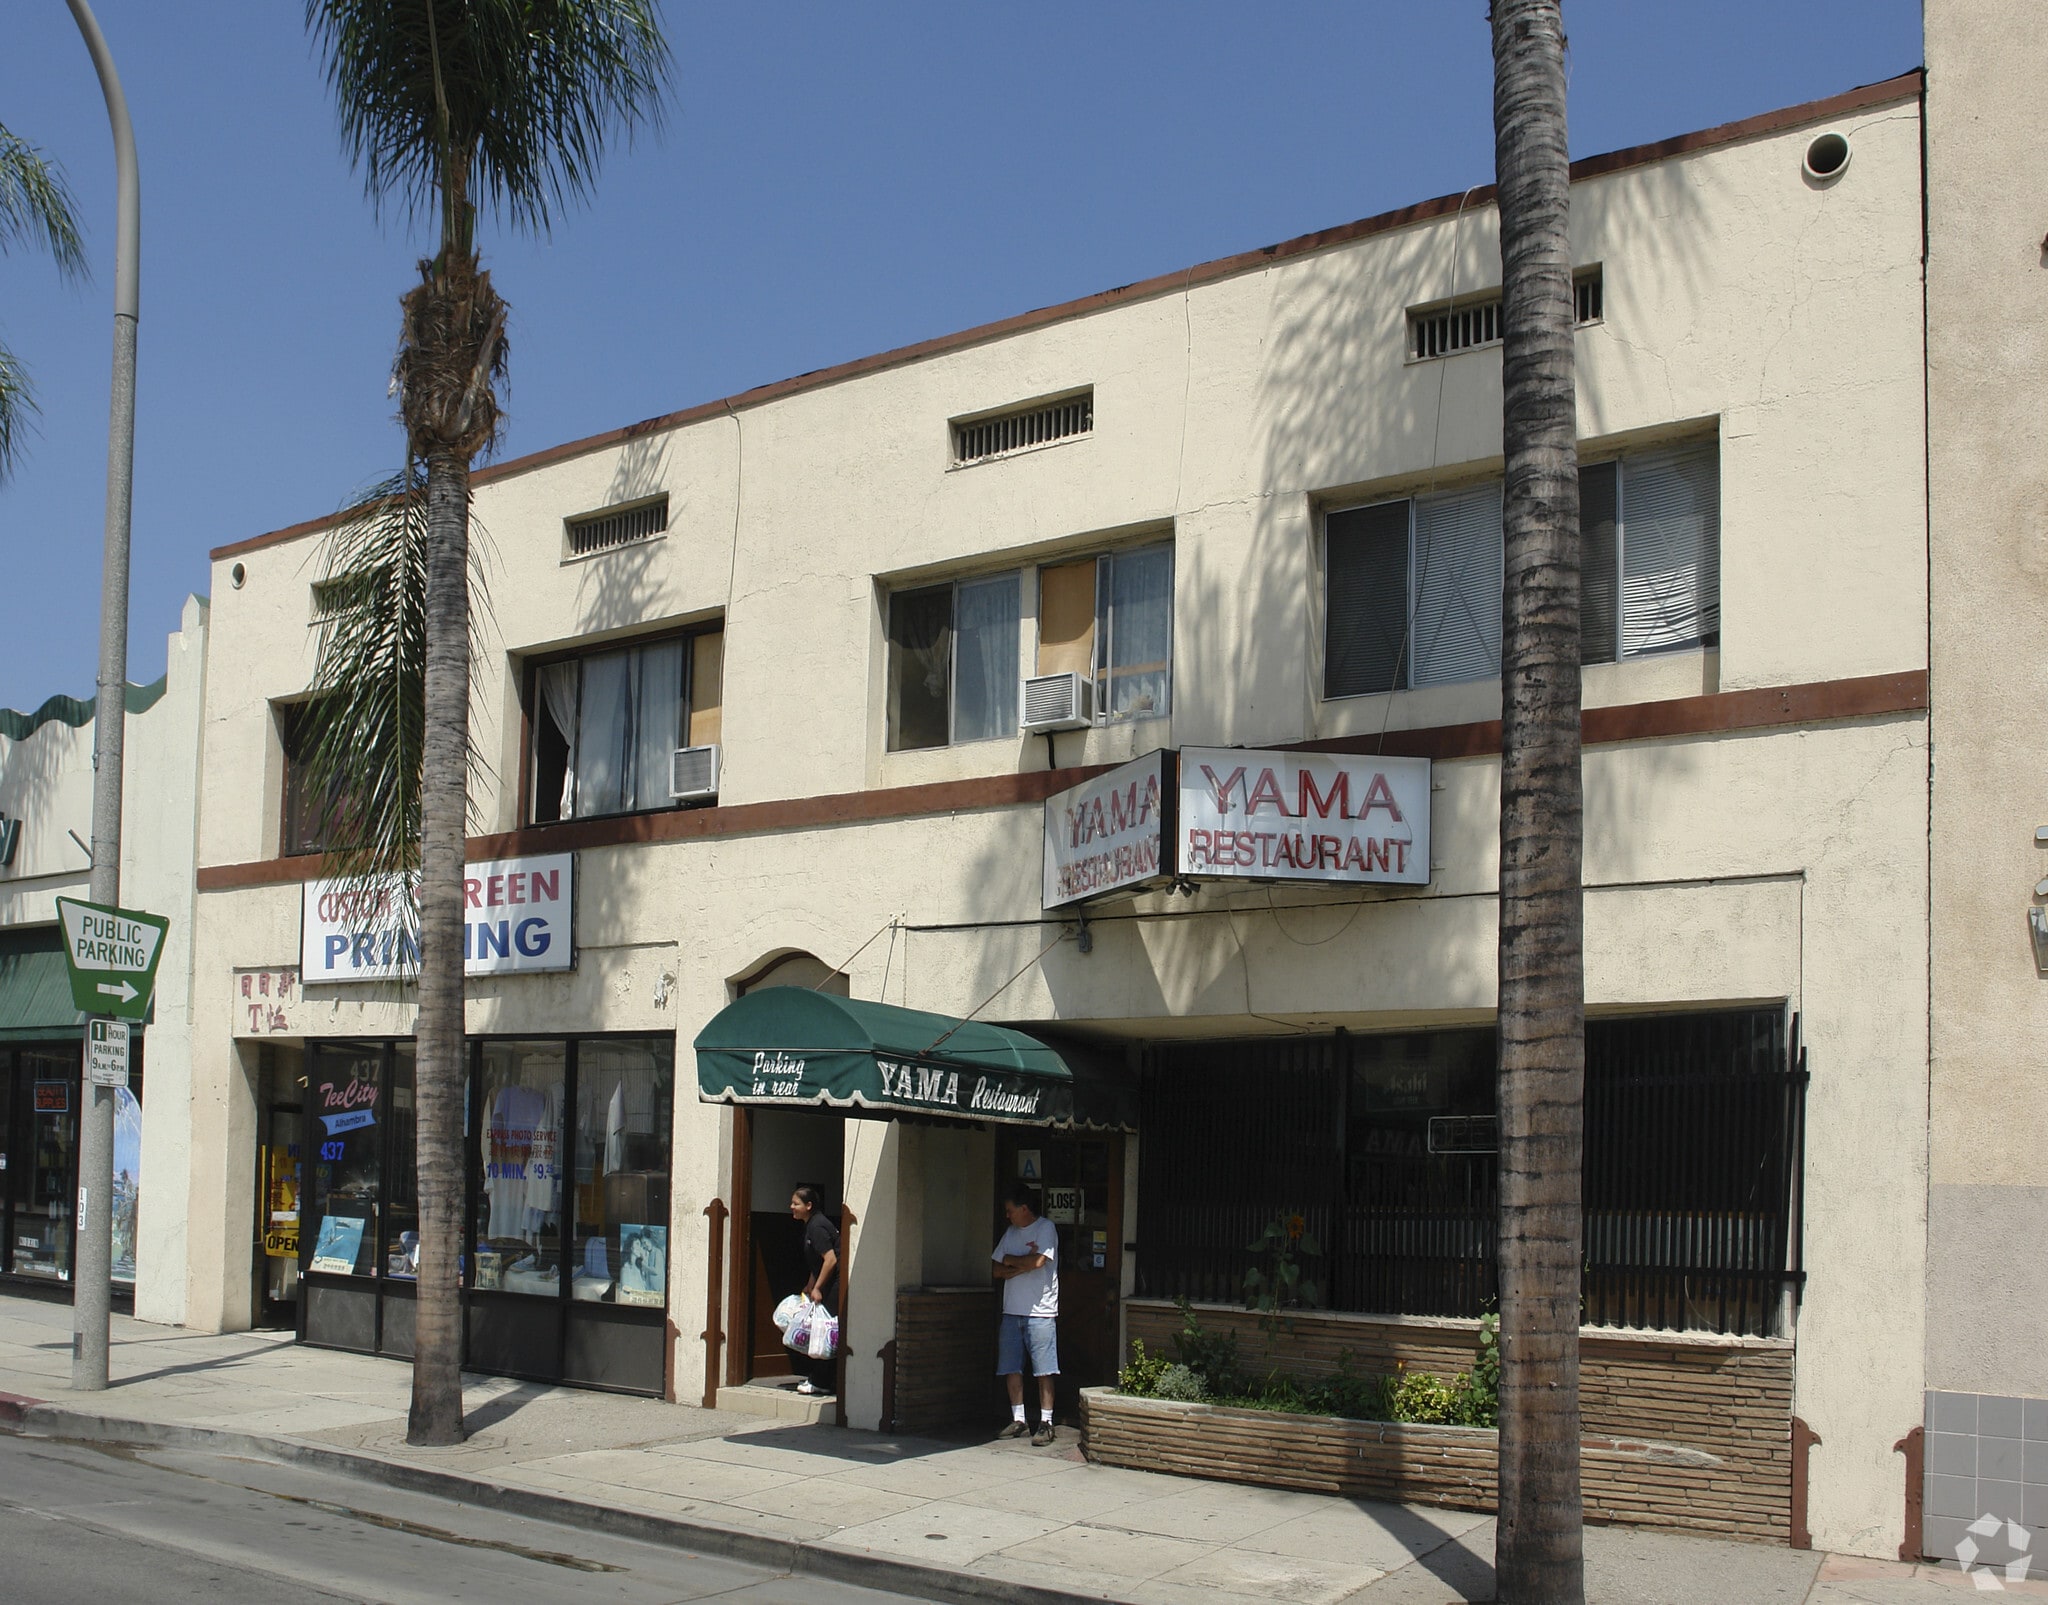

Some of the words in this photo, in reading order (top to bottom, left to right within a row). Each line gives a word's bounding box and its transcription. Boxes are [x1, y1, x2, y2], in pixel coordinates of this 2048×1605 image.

[1200, 765, 1402, 823] YAMA
[1067, 774, 1160, 849] YAMA
[1189, 829, 1412, 873] RESTAURANT
[83, 916, 141, 944] PUBLIC
[77, 938, 145, 967] PARKING
[325, 917, 550, 970] PRINING
[96, 1023, 102, 1040] 1
[108, 1029, 126, 1040] HOUR
[94, 1043, 125, 1057] PARKING
[351, 1060, 380, 1081] 437
[752, 1051, 805, 1080] Parking
[320, 1079, 379, 1108] TeeCity
[753, 1077, 765, 1095] in
[772, 1080, 799, 1096] rear
[877, 1061, 959, 1104] YAMA
[970, 1075, 1040, 1114] Restaurant
[335, 1114, 366, 1129] Alhambra
[511, 1129, 532, 1141] PHOTO
[533, 1131, 557, 1142] SERVICE
[320, 1142, 345, 1161] 437
[487, 1162, 499, 1179] 10
[502, 1163, 527, 1180] MIN.
[1023, 1158, 1036, 1177] A
[267, 1236, 299, 1251] OPEN
